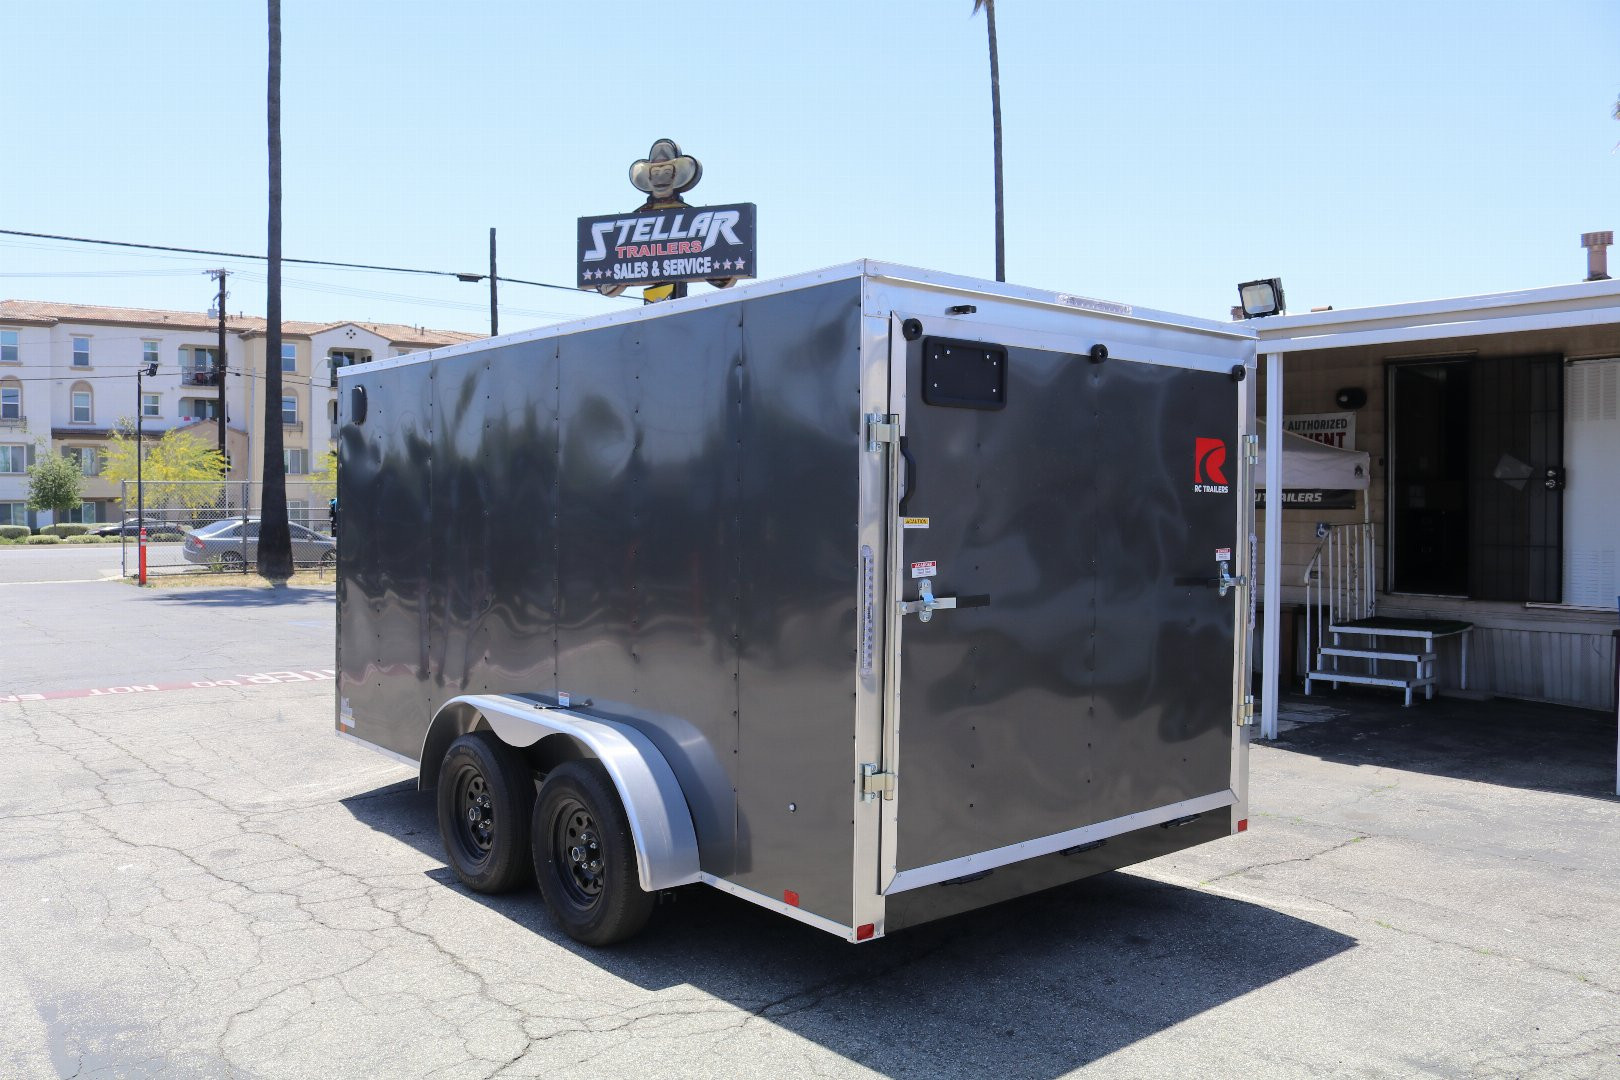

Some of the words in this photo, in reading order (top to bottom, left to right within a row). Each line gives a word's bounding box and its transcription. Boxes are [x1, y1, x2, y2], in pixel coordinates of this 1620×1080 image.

[583, 210, 744, 262] STELLAR
[615, 241, 703, 258] TRAILERS
[613, 262, 649, 280] SALES
[651, 260, 660, 276] &
[663, 257, 712, 275] SERVICE
[1288, 418, 1348, 431] AUTHORIZED
[1194, 484, 1202, 493] RC
[1203, 485, 1229, 494] TRAILERS
[191, 679, 241, 688] DO
[236, 669, 335, 684] TER
[89, 684, 160, 696] NOT
